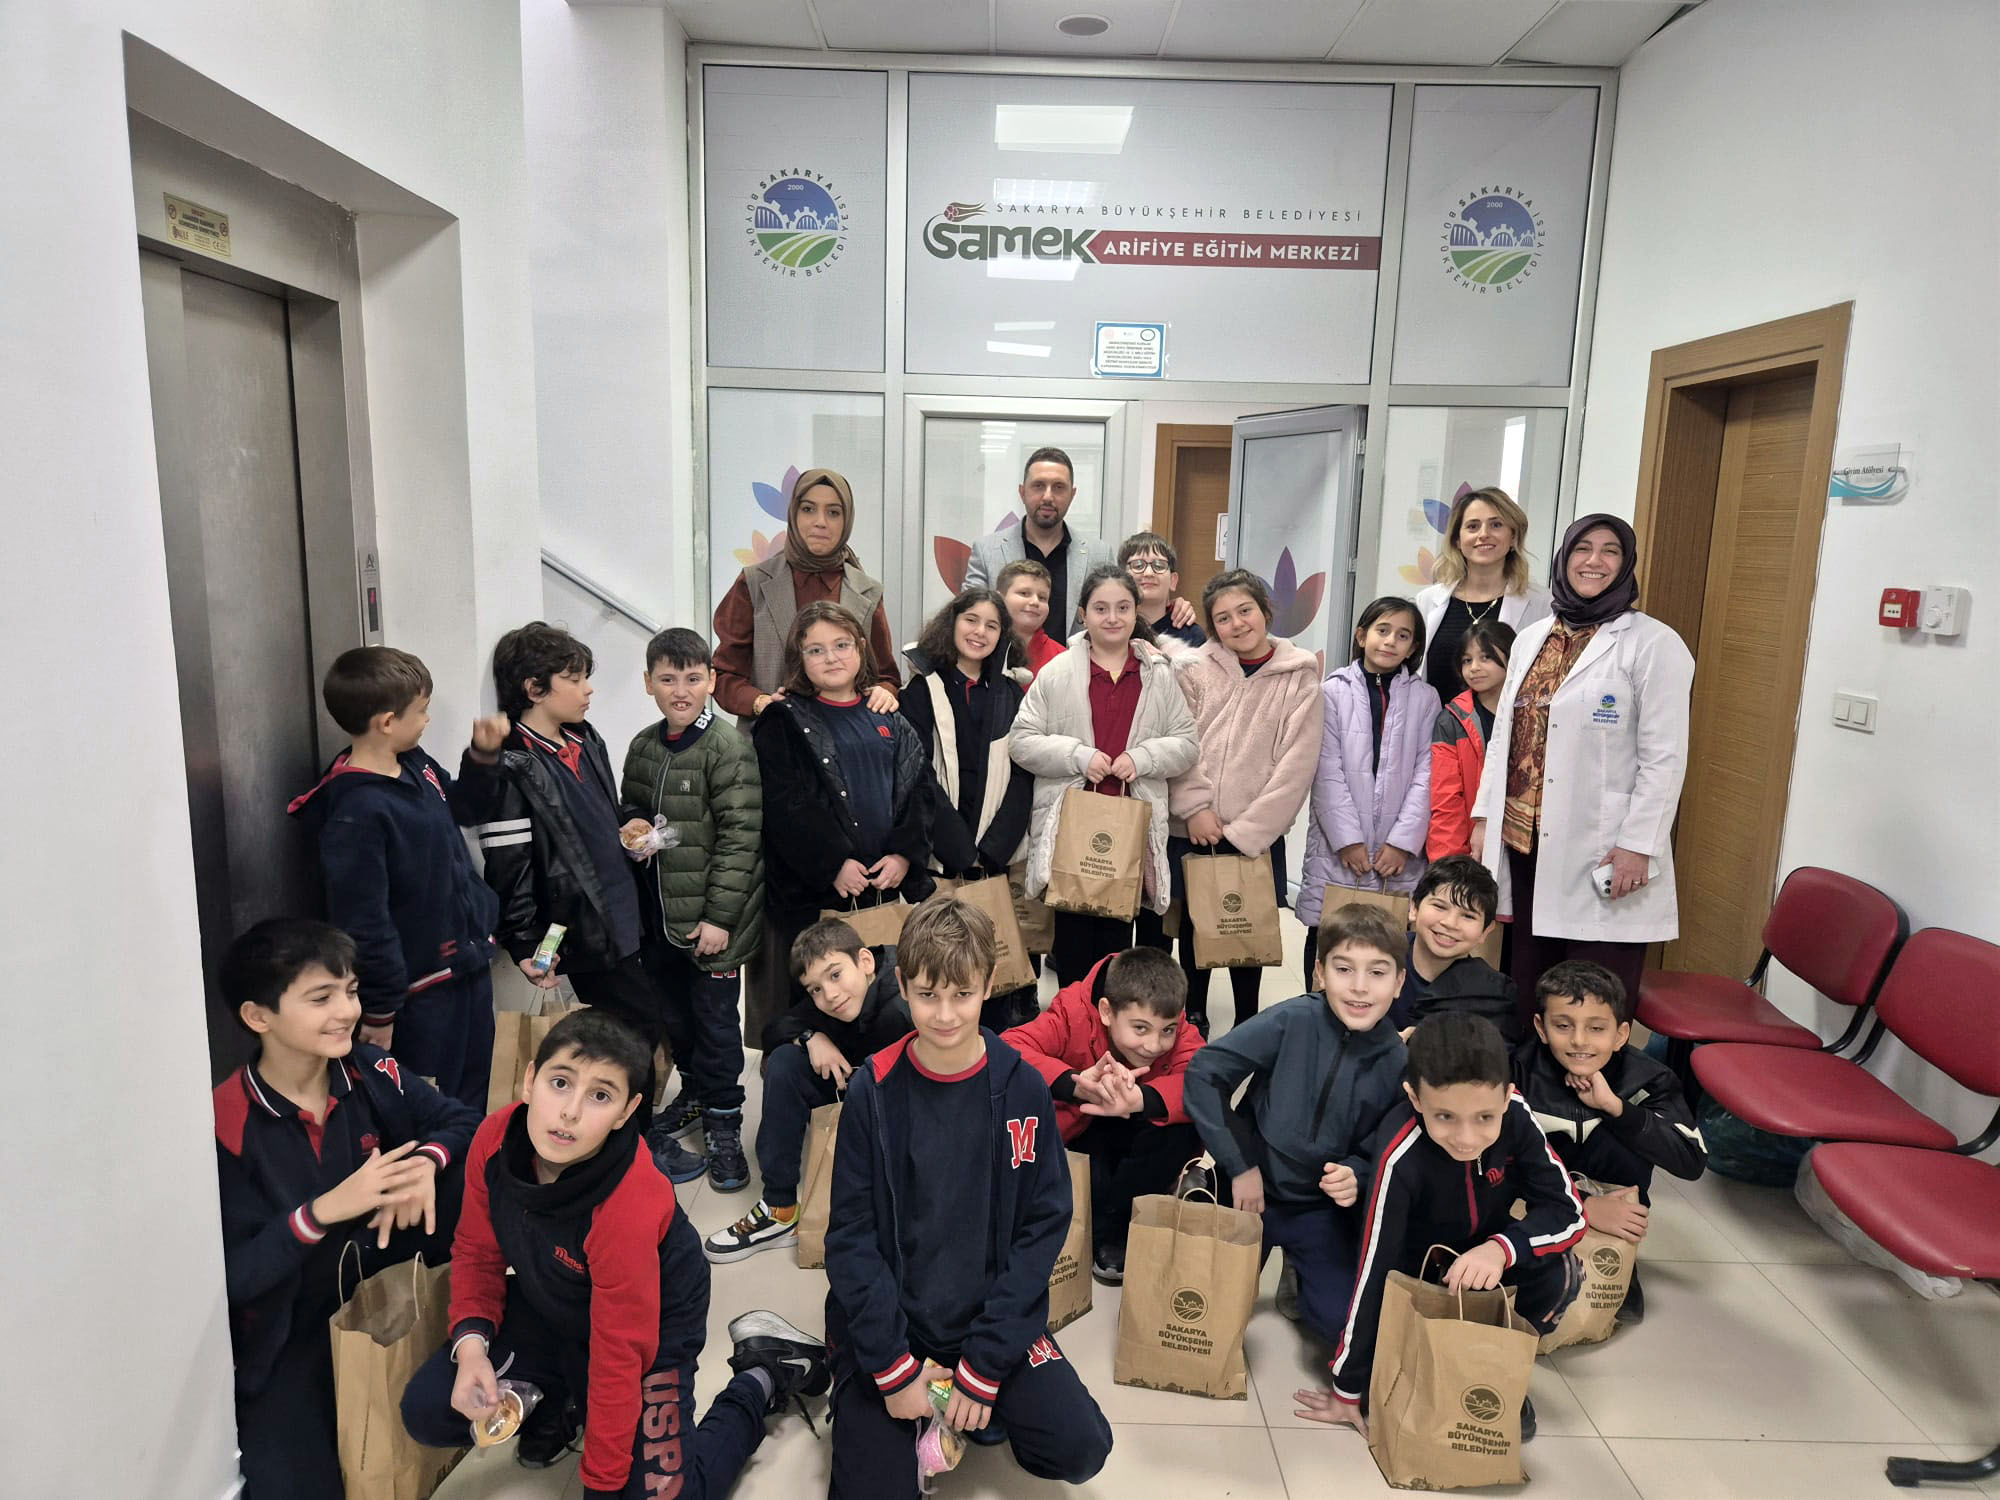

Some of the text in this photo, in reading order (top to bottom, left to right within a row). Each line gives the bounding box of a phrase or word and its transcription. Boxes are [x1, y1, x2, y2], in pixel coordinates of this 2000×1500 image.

[759, 167, 833, 191] SAKARYA
[1458, 185, 1533, 207] SAKARYA
[997, 204, 1360, 221] SAKARYA BÜYÜKŞEHİR BELEDİYESİ
[1103, 237, 1360, 261] ARİFİYE EĞİTİM MERKEZİ
[1007, 1116, 1038, 1169] M
[1158, 1330, 1214, 1347] BÜYÜKŞEHİR
[1165, 1323, 1207, 1337] SAKARYA
[1161, 1340, 1211, 1356] BELEDİYESİ
[1455, 1422, 1504, 1438] SAKARYA
[1447, 1431, 1511, 1448] BÜYÜKŞEHİR
[1451, 1442, 1508, 1456] BELEDİYESİ
